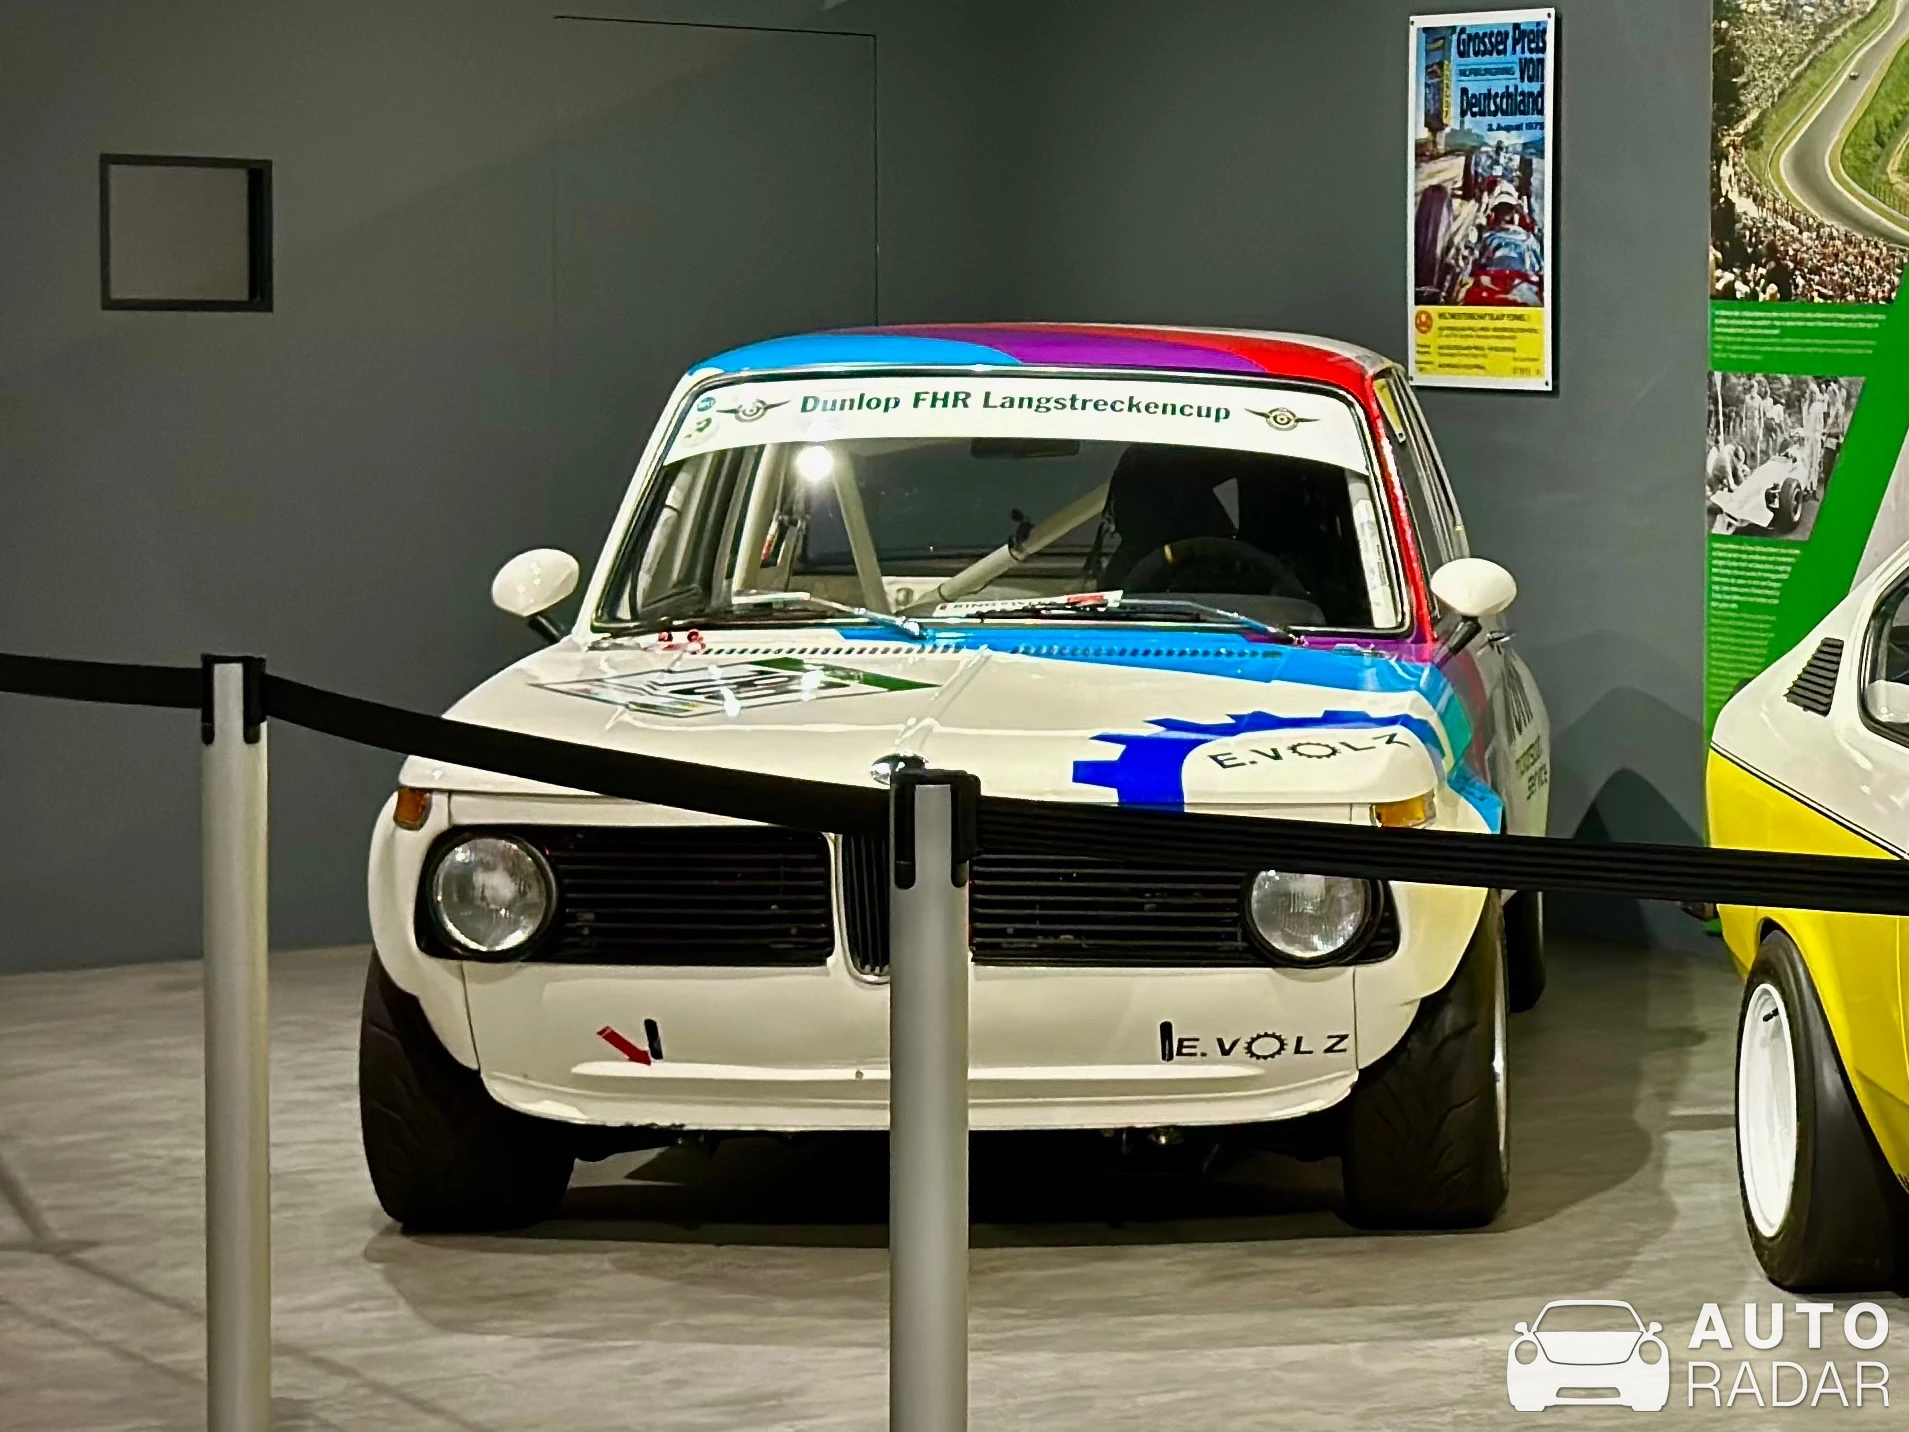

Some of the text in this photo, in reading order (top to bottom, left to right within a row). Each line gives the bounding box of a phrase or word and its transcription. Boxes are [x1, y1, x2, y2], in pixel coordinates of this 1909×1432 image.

[1456, 22, 1546, 58] Grosser Preis
[1519, 57, 1544, 83] von
[1460, 84, 1544, 118] Deutschland
[800, 390, 1231, 423] Dunlop FHR Langstreckencup
[1175, 1032, 1349, 1060] E.VOLZ
